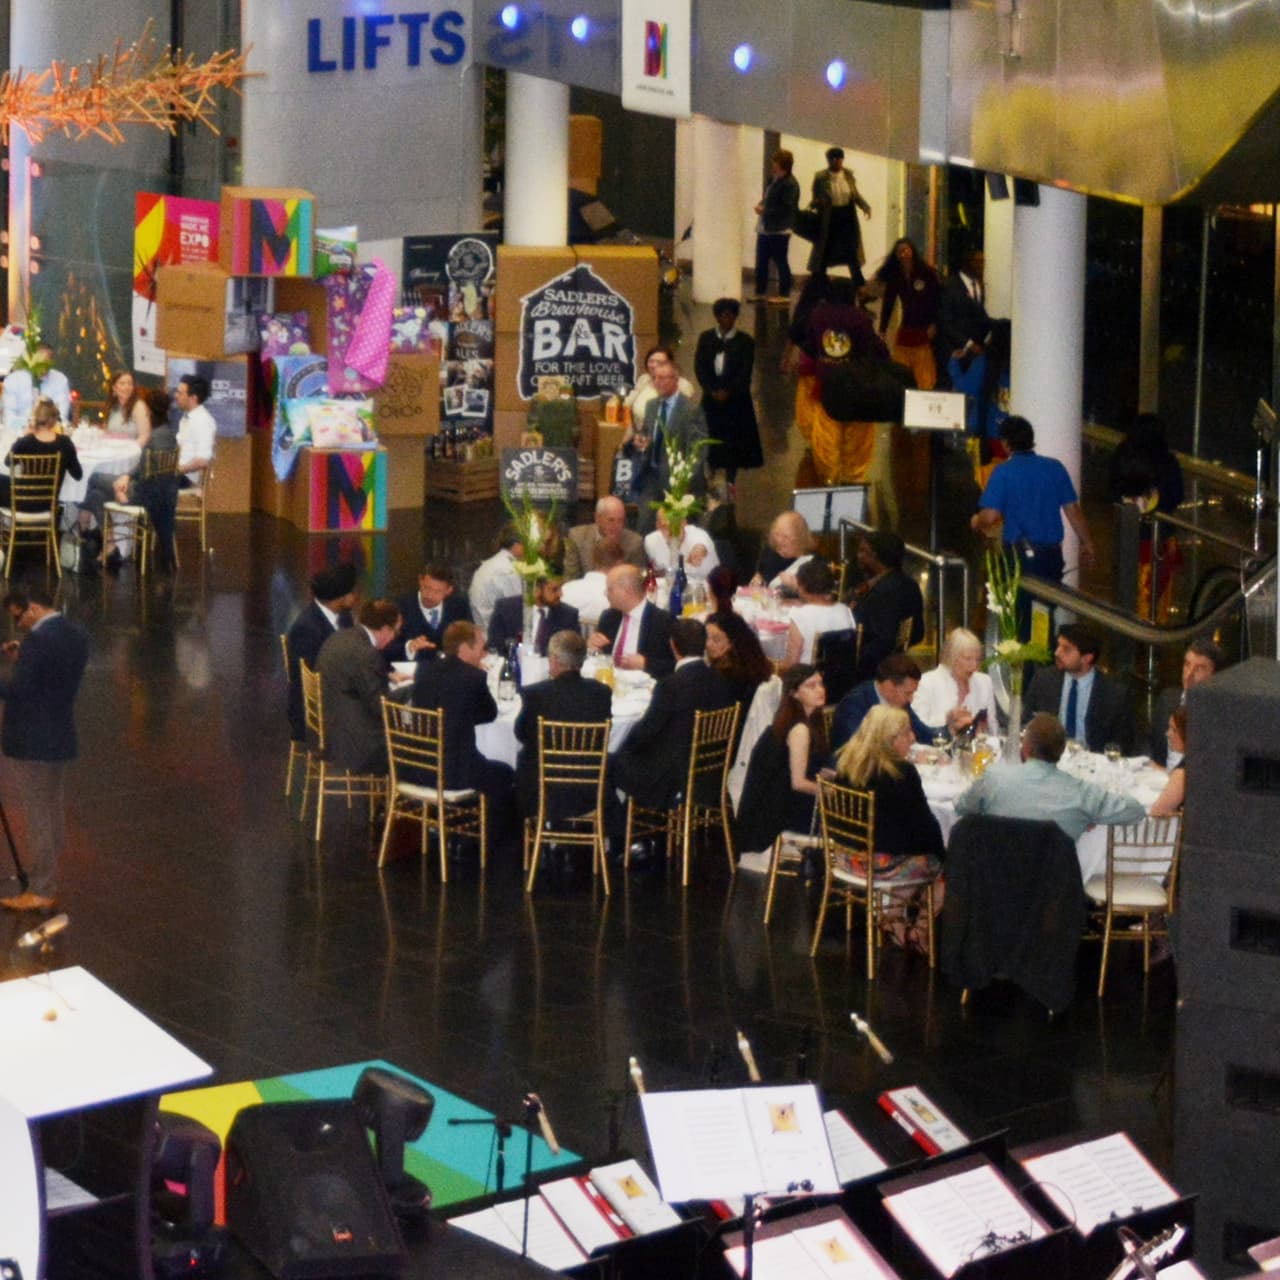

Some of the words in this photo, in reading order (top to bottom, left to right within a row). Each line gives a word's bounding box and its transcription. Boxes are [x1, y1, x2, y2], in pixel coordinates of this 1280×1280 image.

[307, 10, 466, 73] LIFTS
[180, 231, 209, 248] EXPO
[543, 288, 620, 307] SADLERS
[530, 300, 626, 325] Brewhouse
[532, 318, 629, 364] BAR
[535, 362, 559, 373] FOR
[563, 362, 586, 373] THE
[589, 362, 620, 374] LOVE
[560, 373, 593, 386] RAFT
[597, 374, 625, 387] BEER
